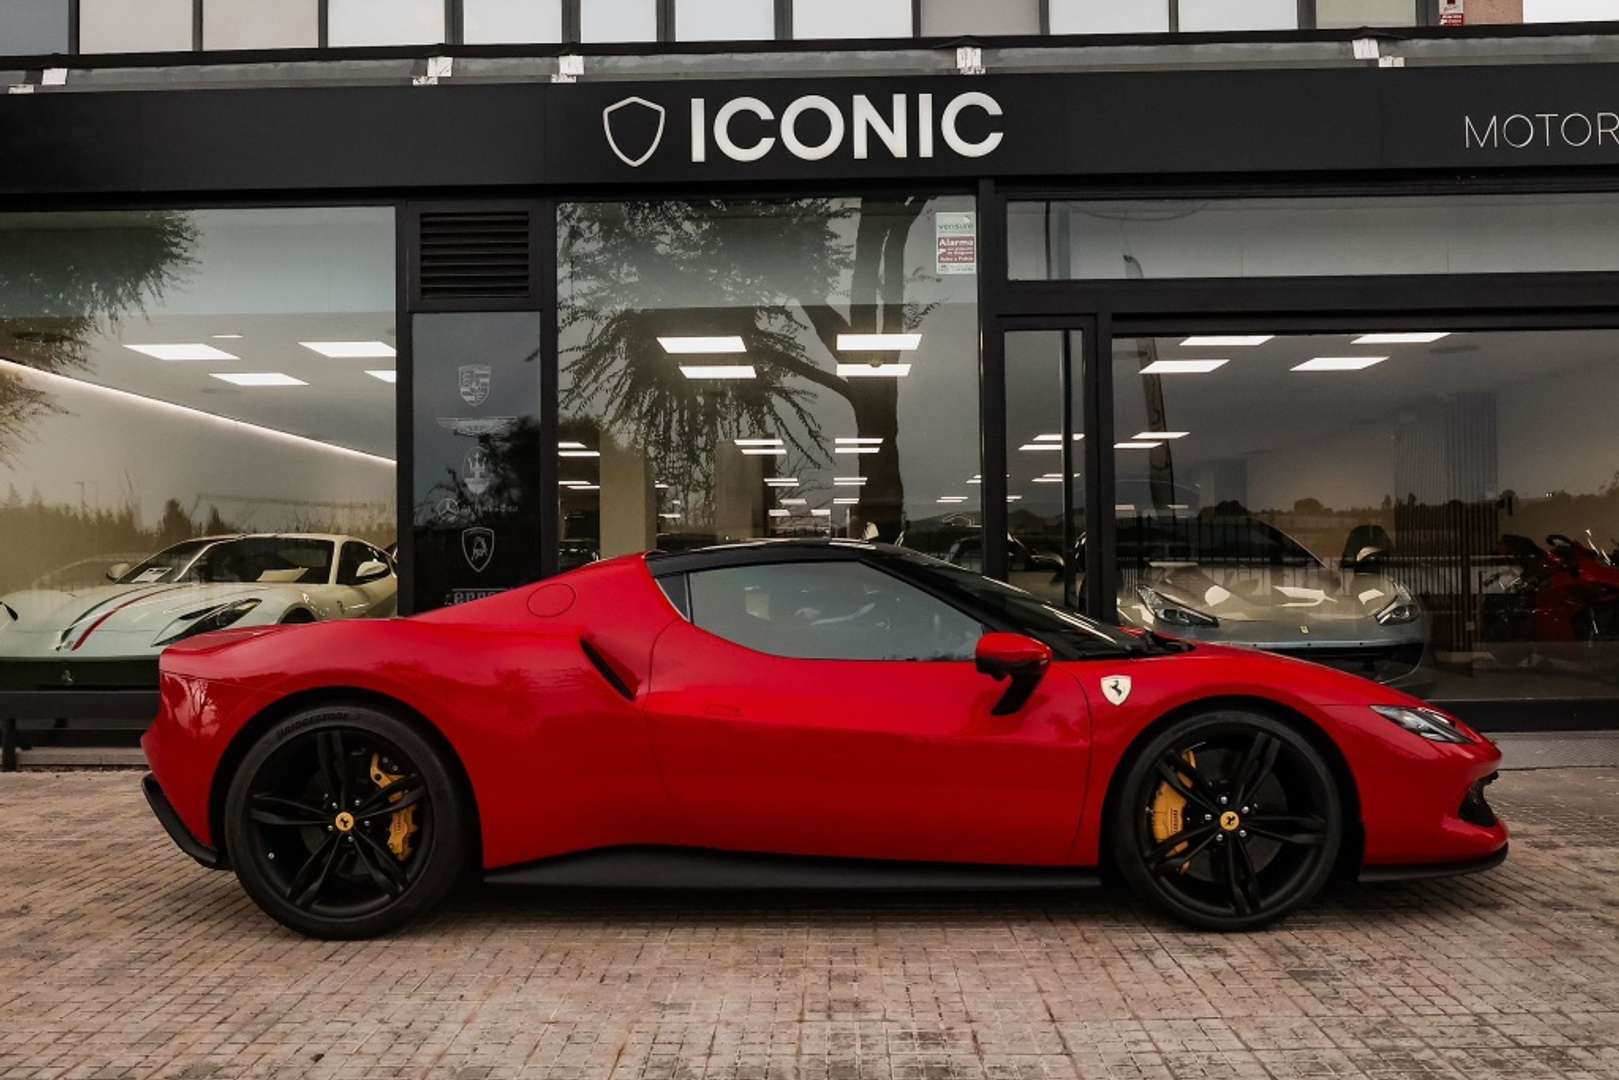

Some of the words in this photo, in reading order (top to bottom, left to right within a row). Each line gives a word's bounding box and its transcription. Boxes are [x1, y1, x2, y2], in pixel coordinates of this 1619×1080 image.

[691, 91, 1004, 162] ICONIC
[1465, 112, 1619, 148] MOTOR
[939, 238, 974, 247] Alarma
